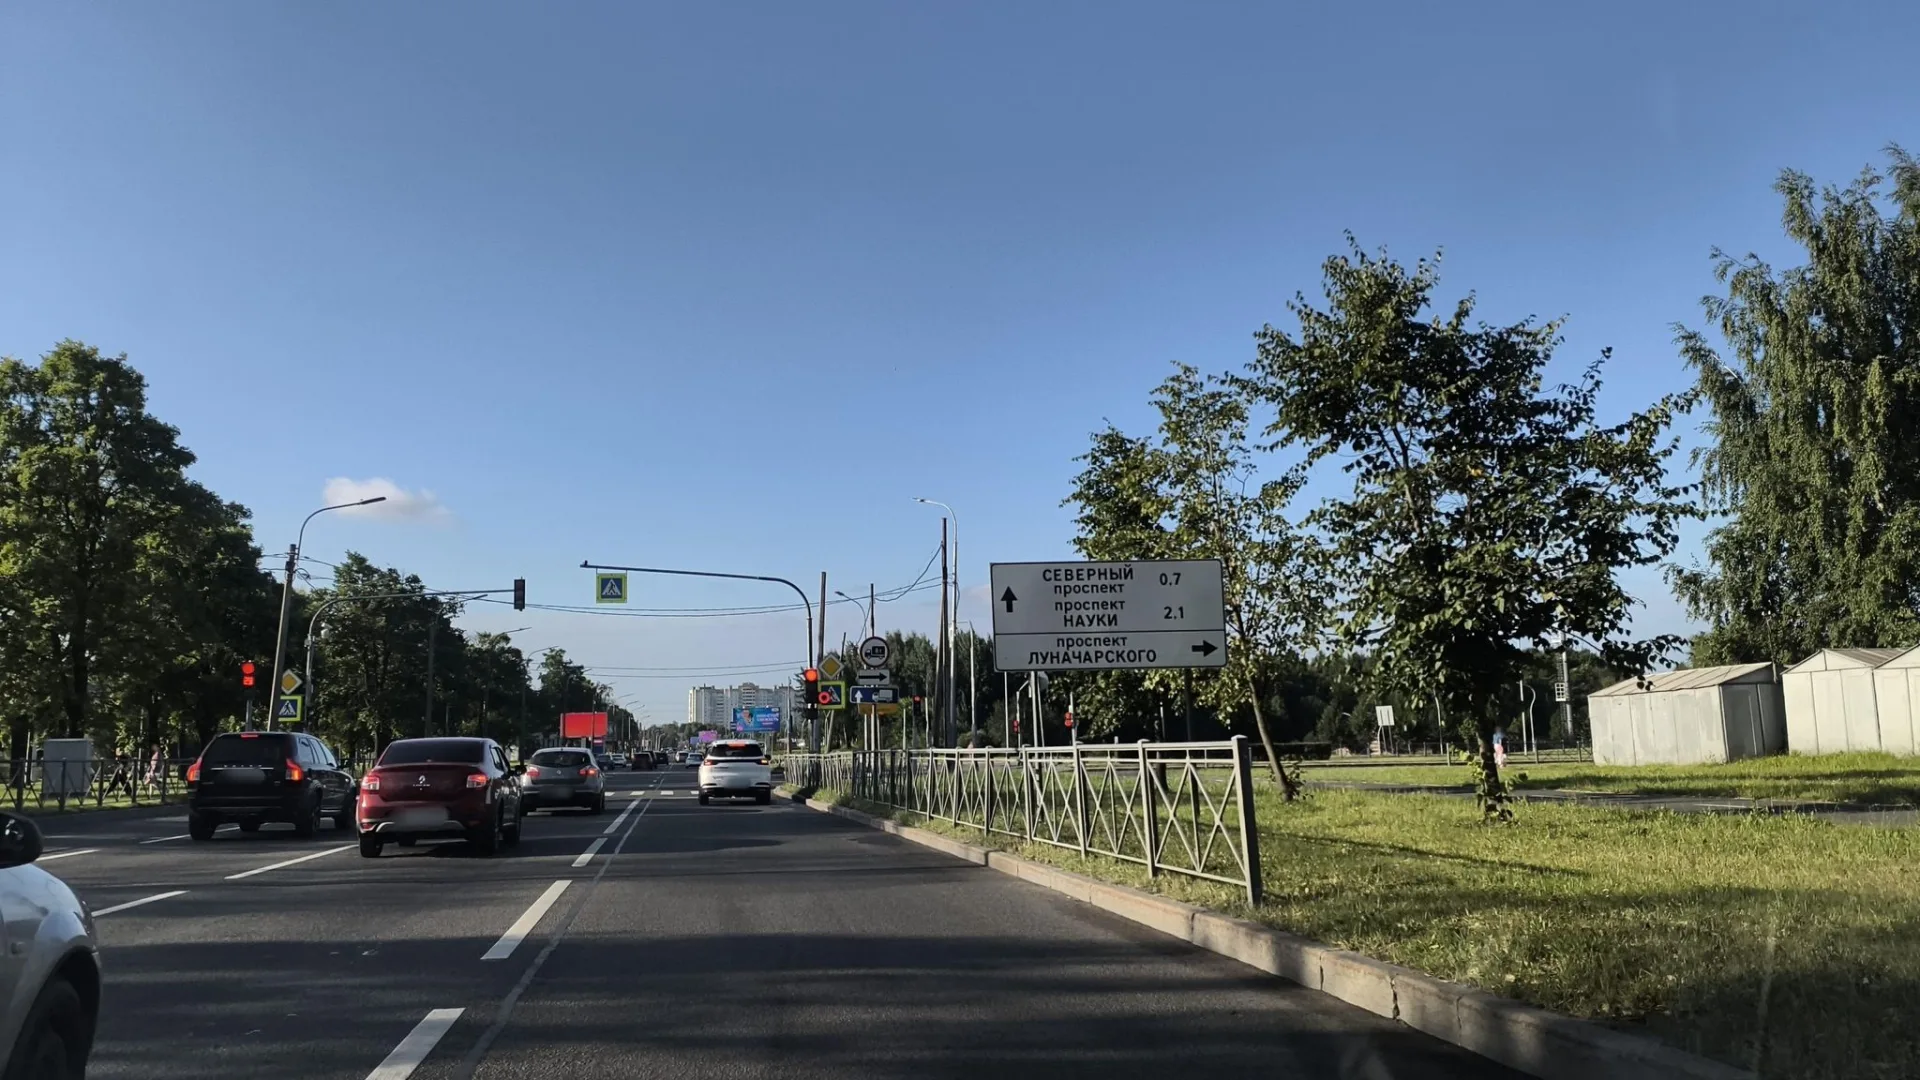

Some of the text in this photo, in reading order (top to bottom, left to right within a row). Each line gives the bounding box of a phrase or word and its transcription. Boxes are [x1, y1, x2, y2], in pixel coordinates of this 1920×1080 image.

[1043, 564, 1134, 581] СЕВЕРНЫЙ
[1160, 573, 1181, 586] 0.7
[1054, 583, 1124, 597] проспект
[1055, 600, 1125, 613] проспект
[1164, 607, 1184, 619] 2.1
[1064, 614, 1118, 627] НАУКИ
[1057, 637, 1127, 650] проспект
[1028, 650, 1156, 665] ЛУНАЧАРСКОГО
